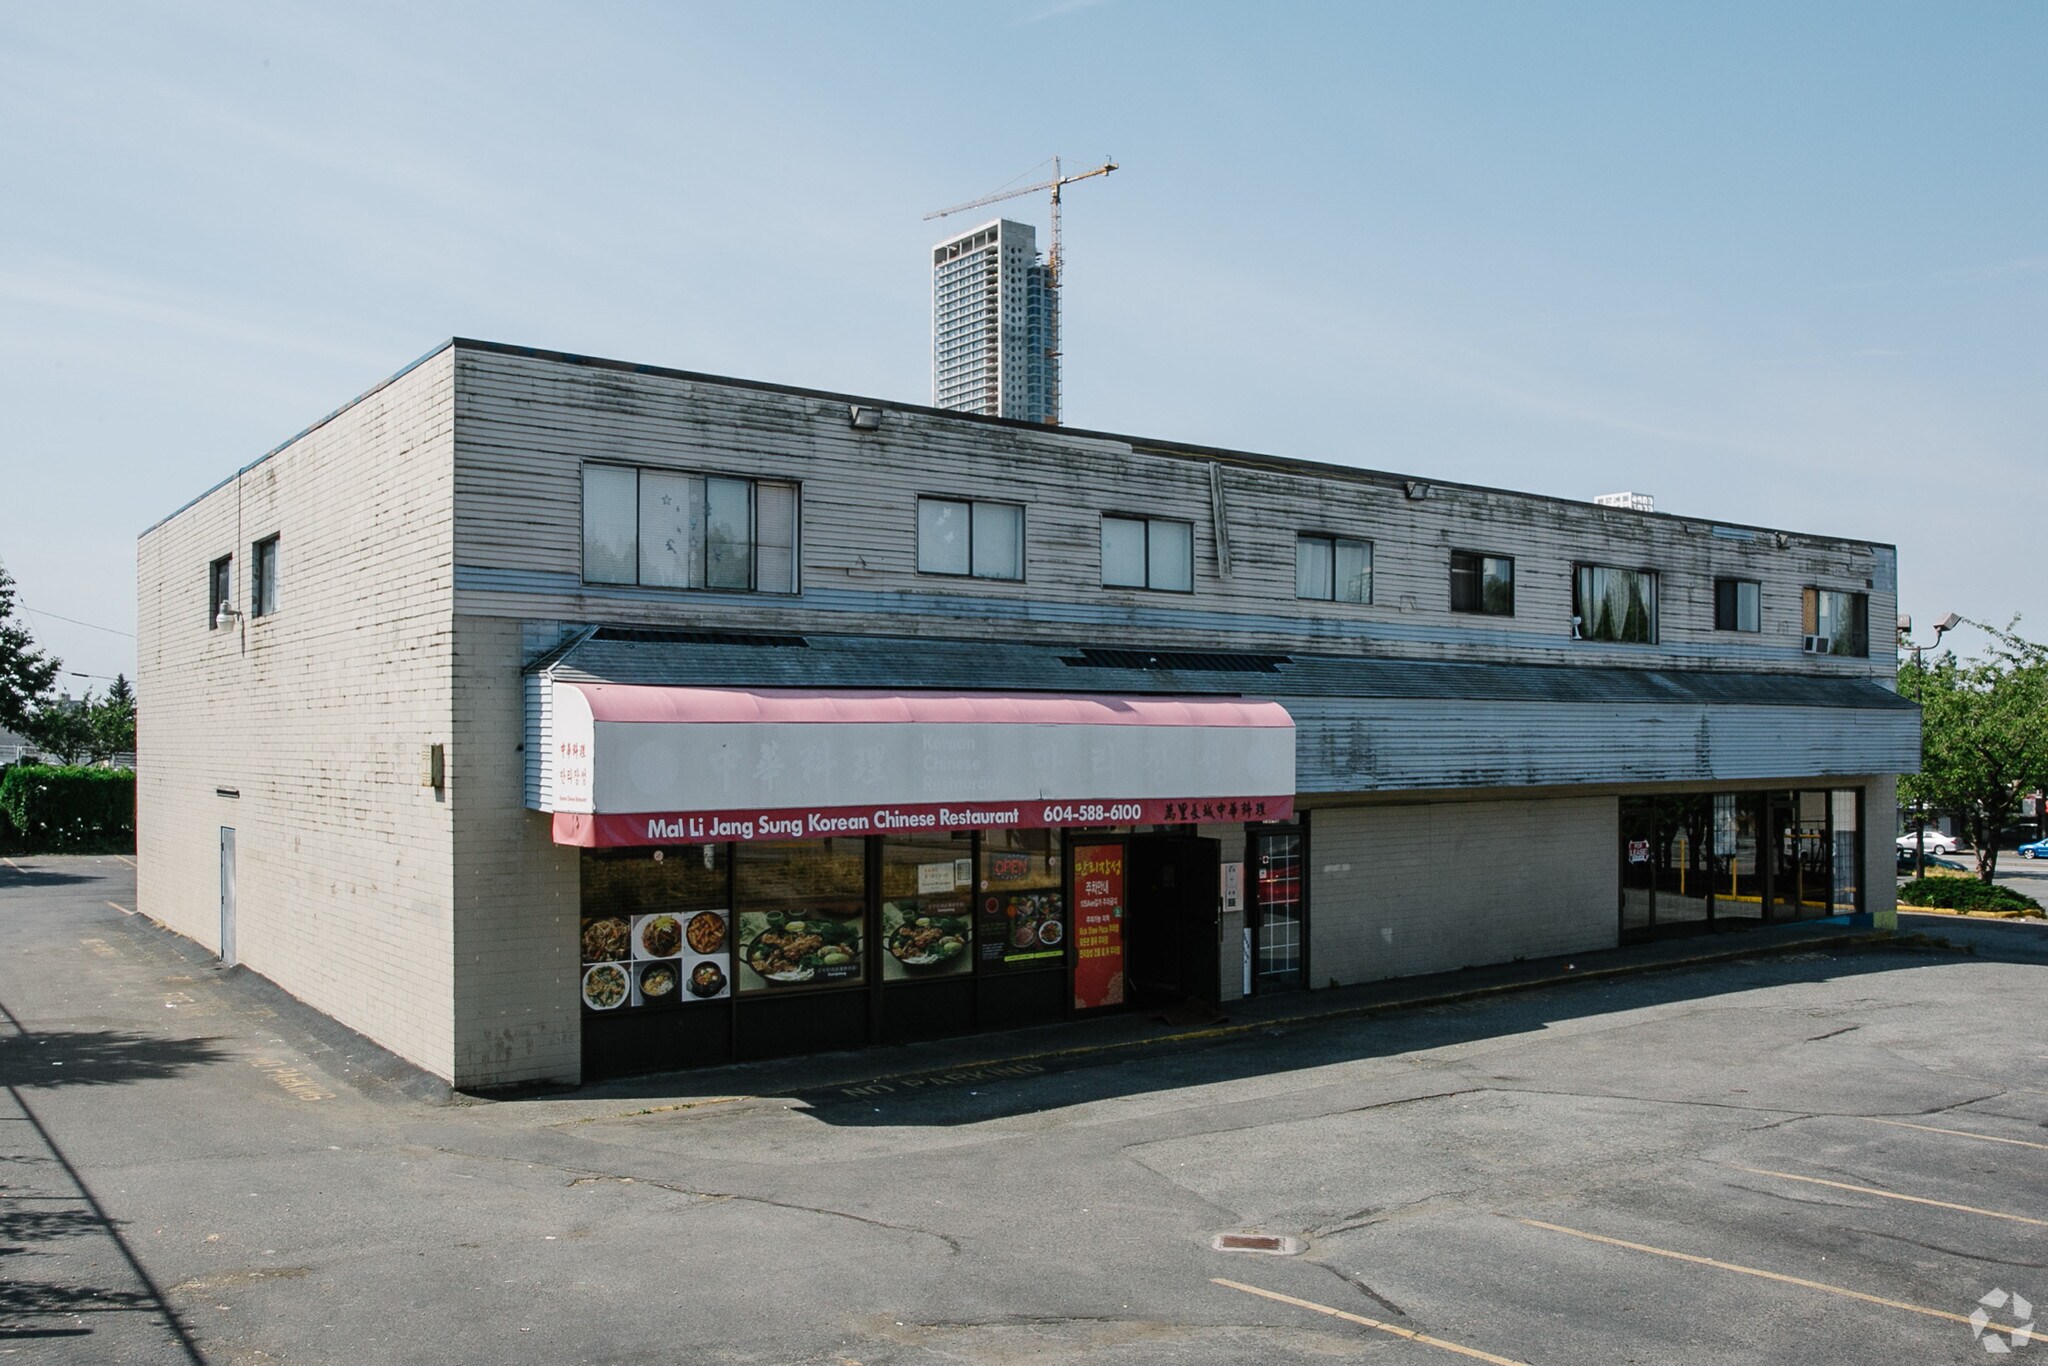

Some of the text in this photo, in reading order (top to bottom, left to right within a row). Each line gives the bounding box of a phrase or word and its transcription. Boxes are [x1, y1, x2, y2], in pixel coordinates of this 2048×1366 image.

[648, 803, 1142, 839] Mal Li Jang Sung Korean Chinese Restaurant 604-588-6100
[993, 858, 1028, 874] OPEN
[1075, 859, 1121, 876] 만리장성
